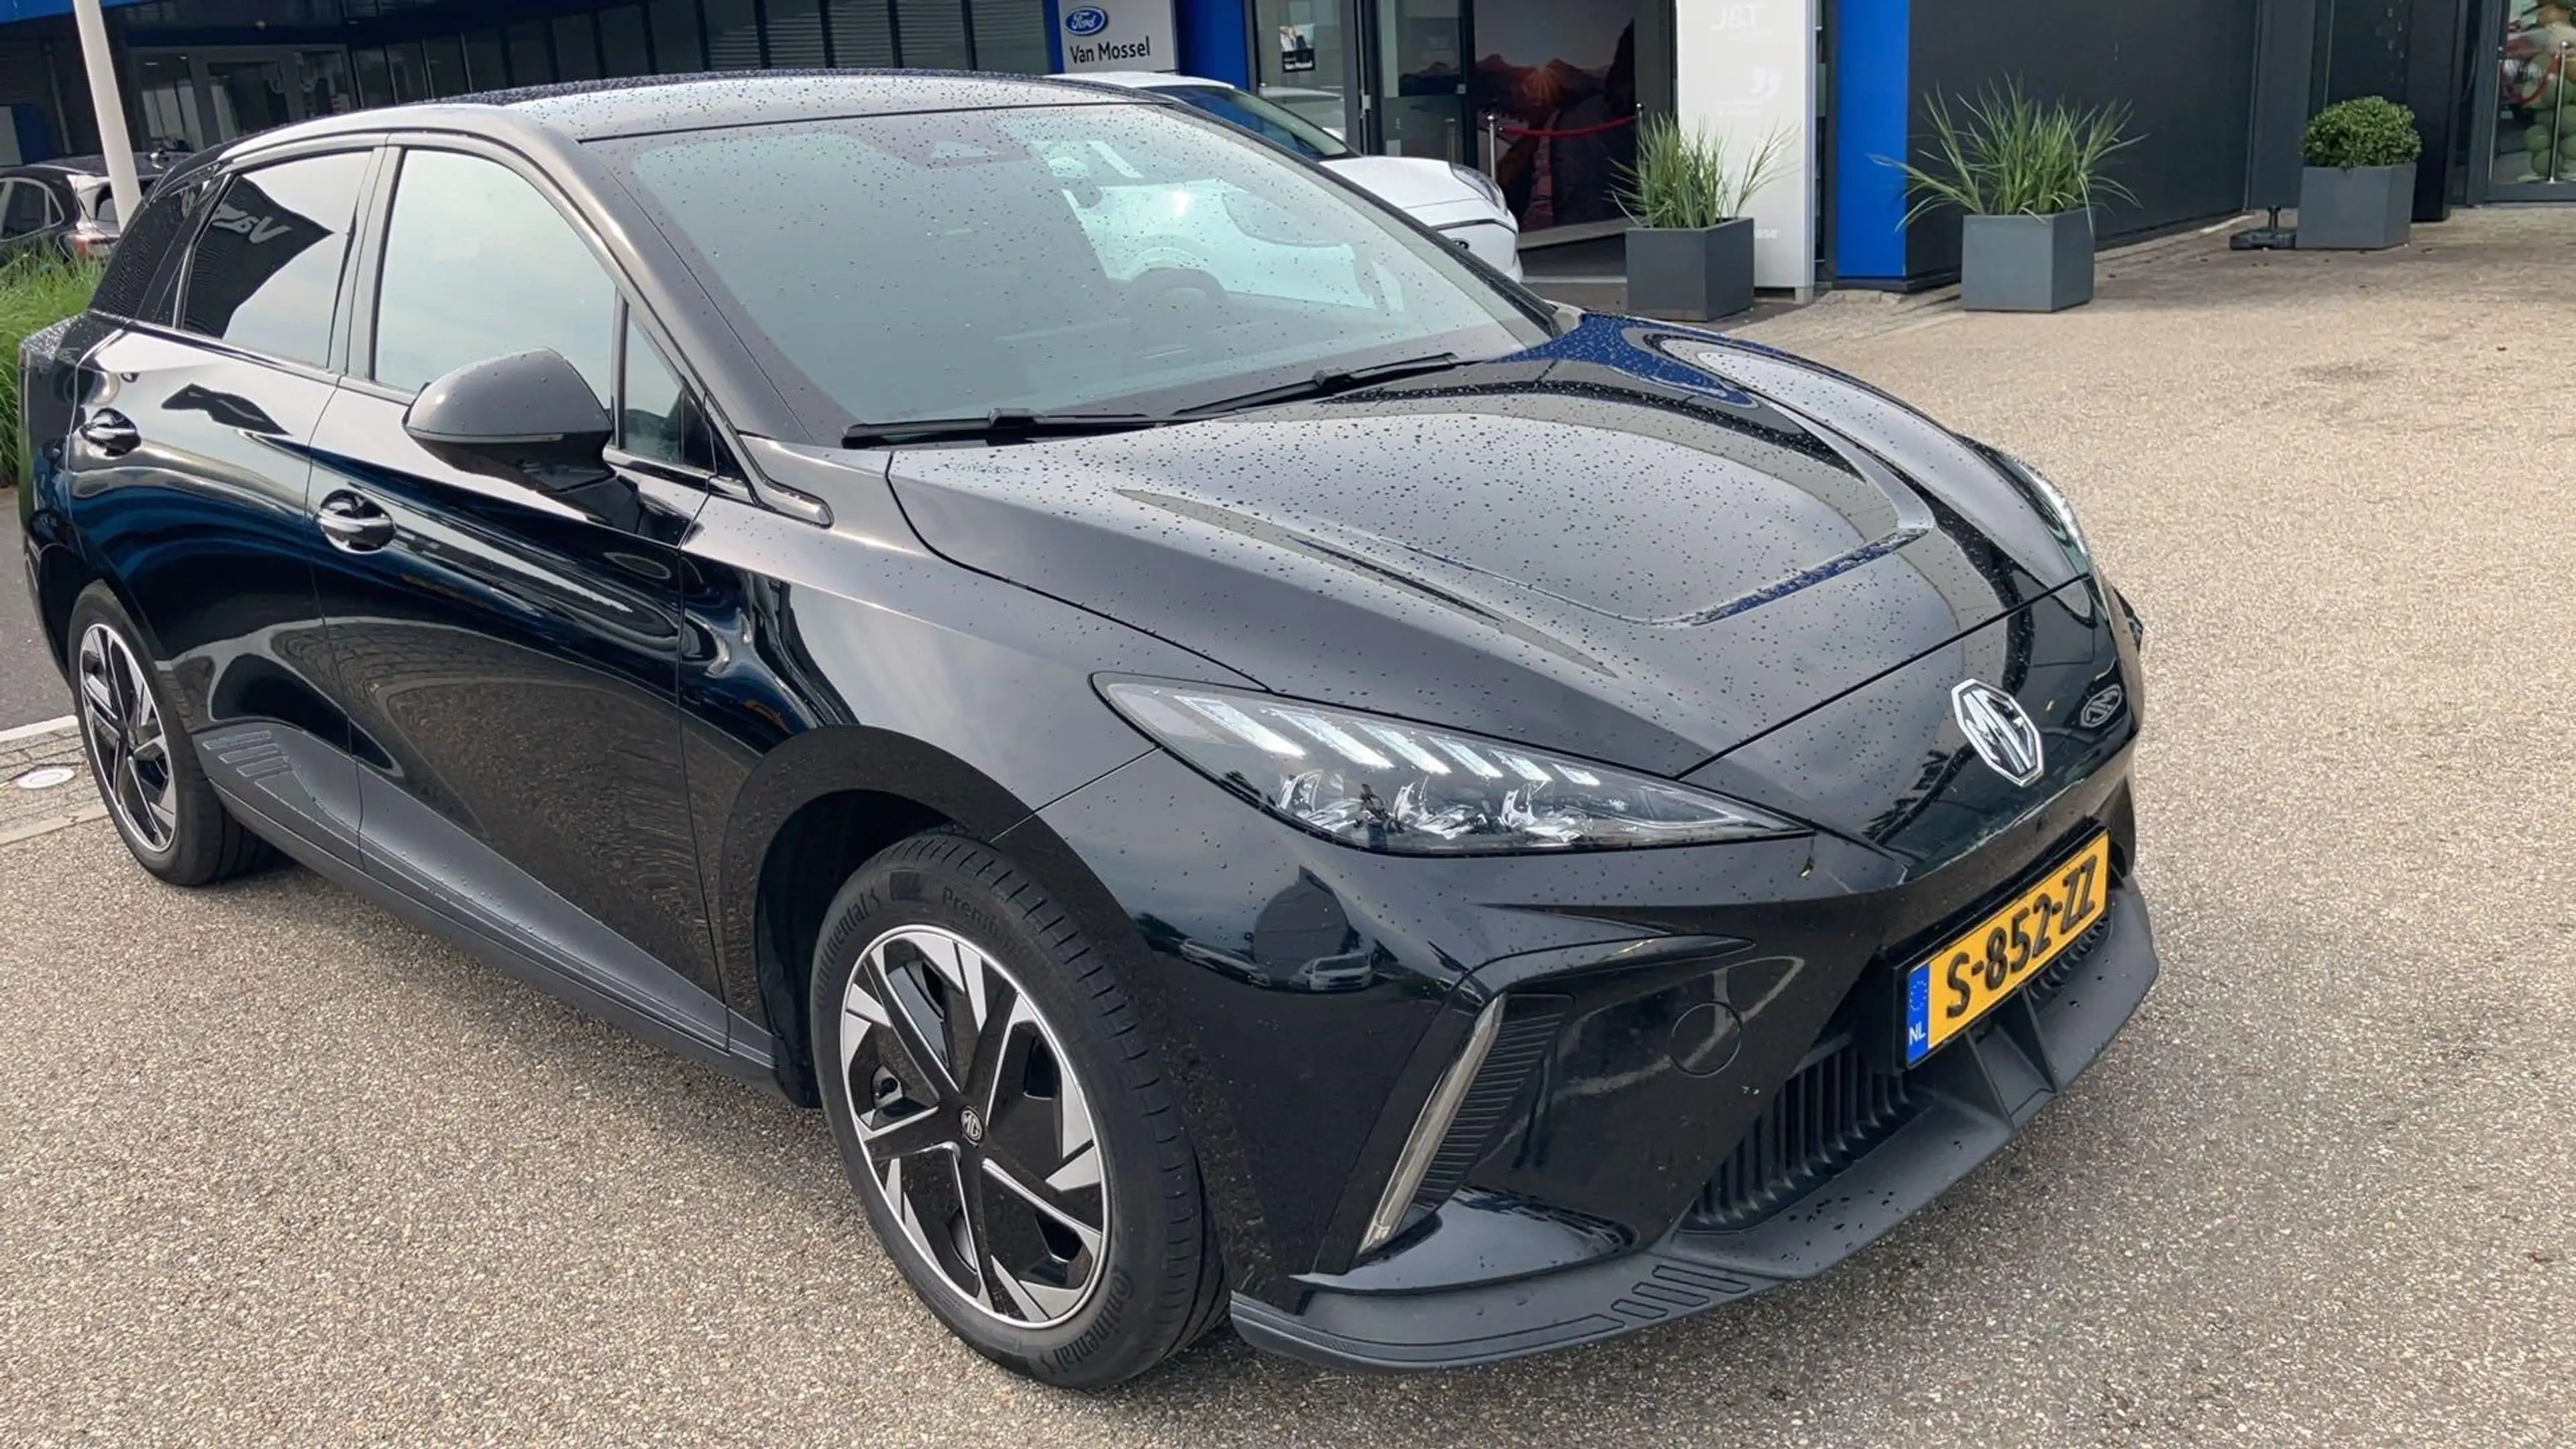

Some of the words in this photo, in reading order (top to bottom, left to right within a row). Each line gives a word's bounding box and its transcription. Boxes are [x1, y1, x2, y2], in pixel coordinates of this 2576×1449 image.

[1070, 11, 1098, 30] Ford
[1069, 45, 1095, 64] Van
[1097, 36, 1150, 60] Mossel
[1957, 684, 2041, 782] MG
[1946, 854, 2098, 1018] S-852-ZZ
[1909, 1021, 1927, 1046] NL
[961, 1111, 981, 1139] MG
